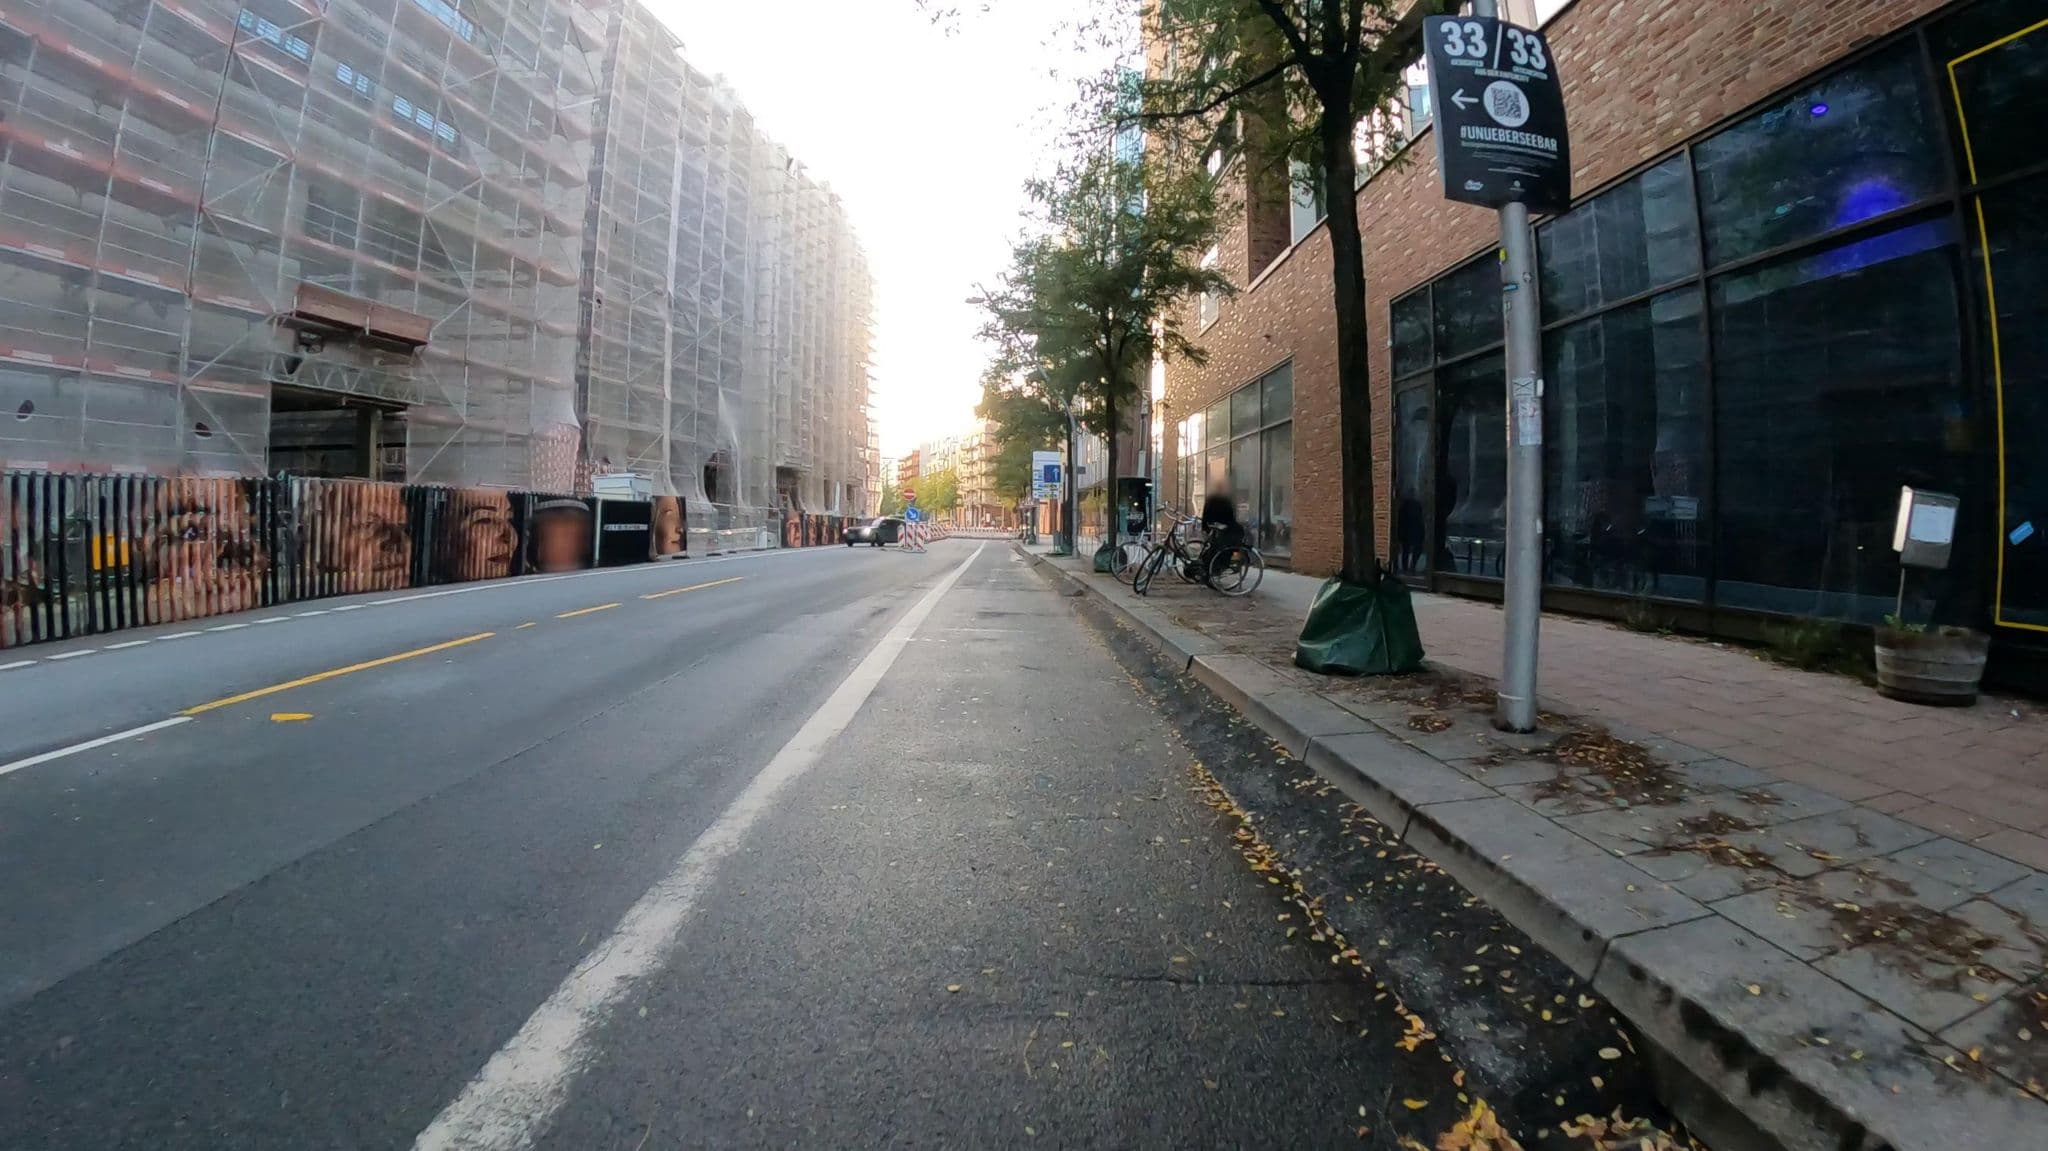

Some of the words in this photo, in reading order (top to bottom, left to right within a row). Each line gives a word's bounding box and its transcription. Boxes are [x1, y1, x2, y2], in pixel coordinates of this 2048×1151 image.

[1440, 21, 1488, 58] 33
[1507, 28, 1547, 71] 33
[1460, 125, 1558, 152] #UNUEBERSEEBAR
